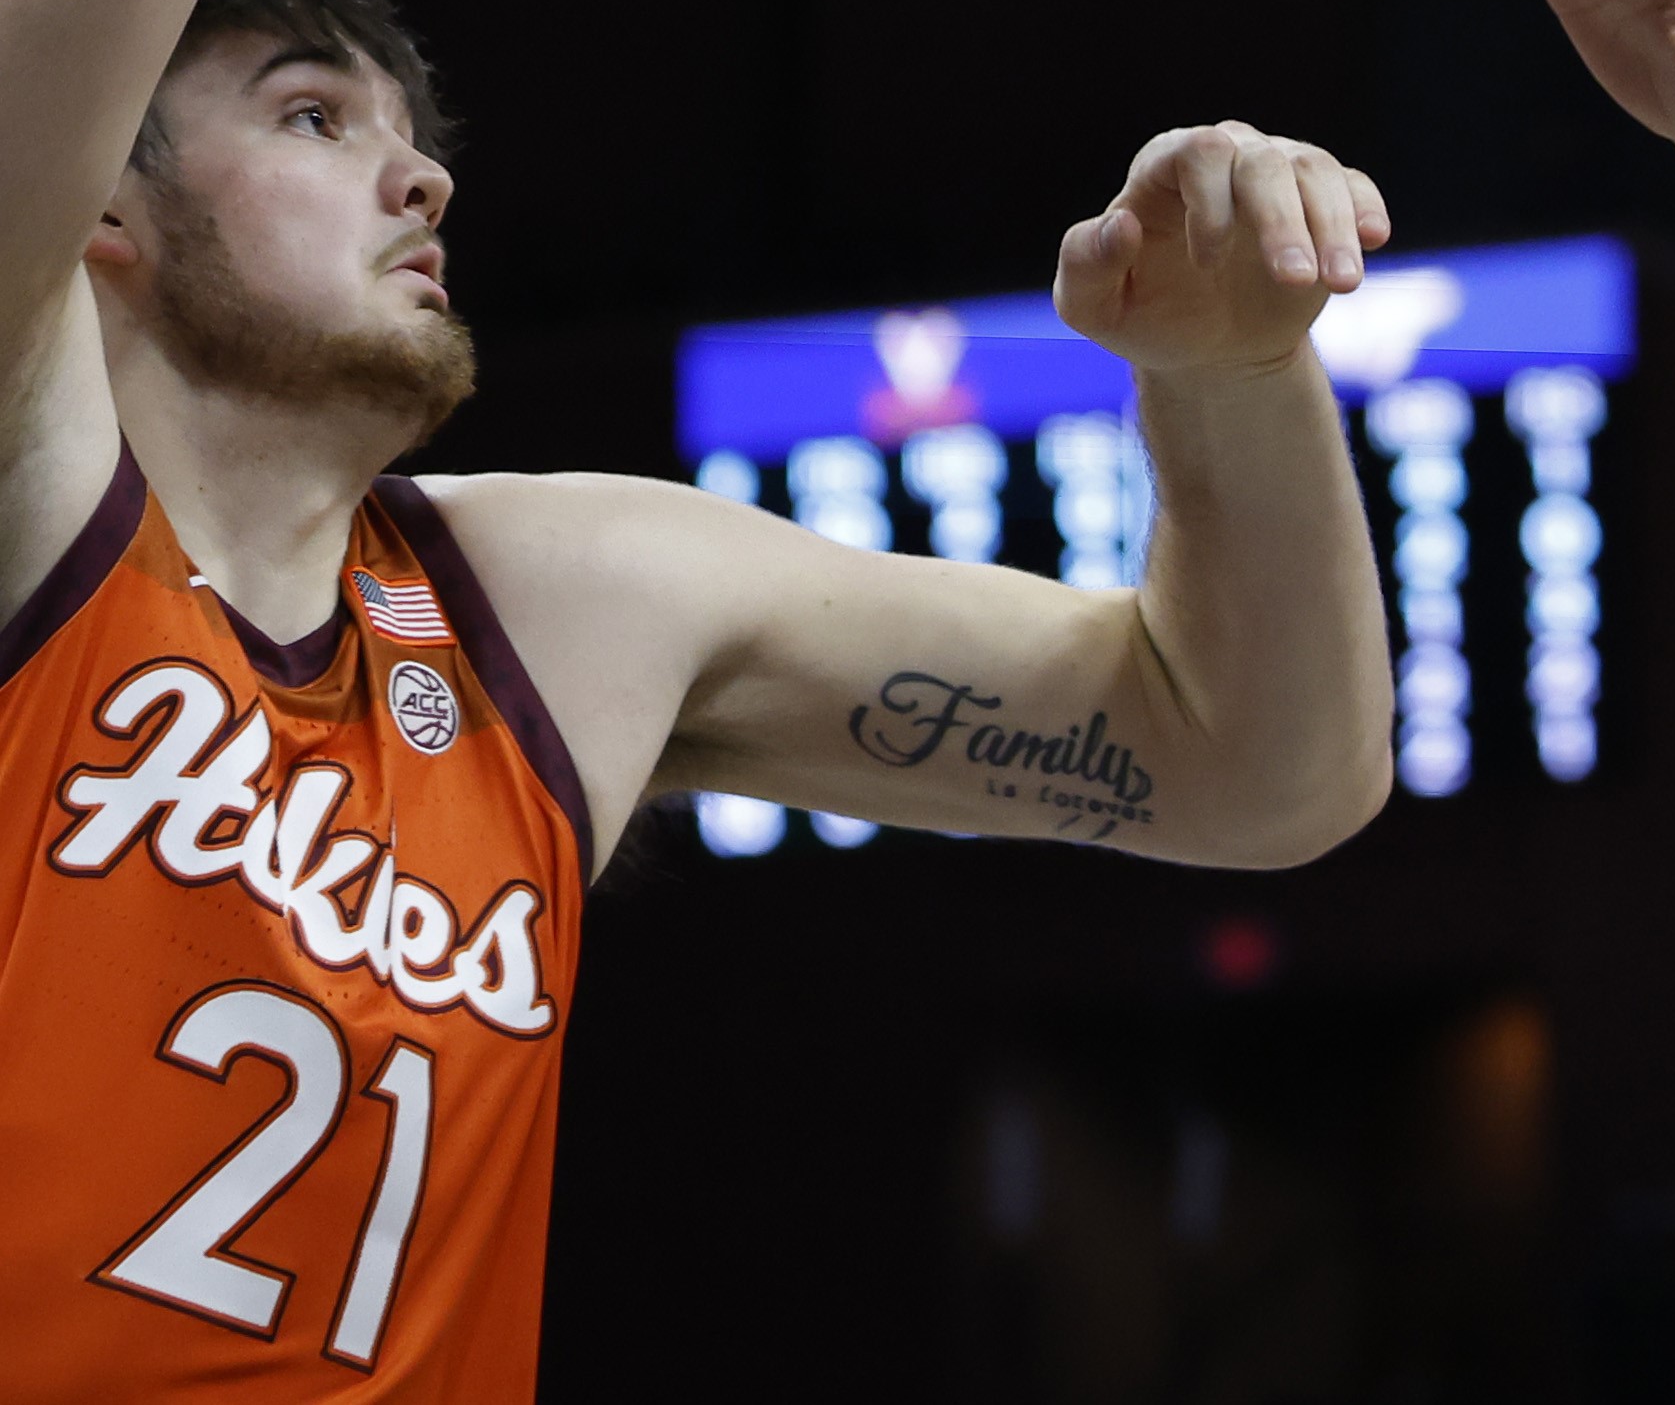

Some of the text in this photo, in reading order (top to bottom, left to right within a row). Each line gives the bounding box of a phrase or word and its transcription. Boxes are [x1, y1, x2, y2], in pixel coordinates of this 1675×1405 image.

[400, 692, 449, 714] ACC
[848, 670, 1152, 803] Family
[84, 977, 436, 1376] 21
